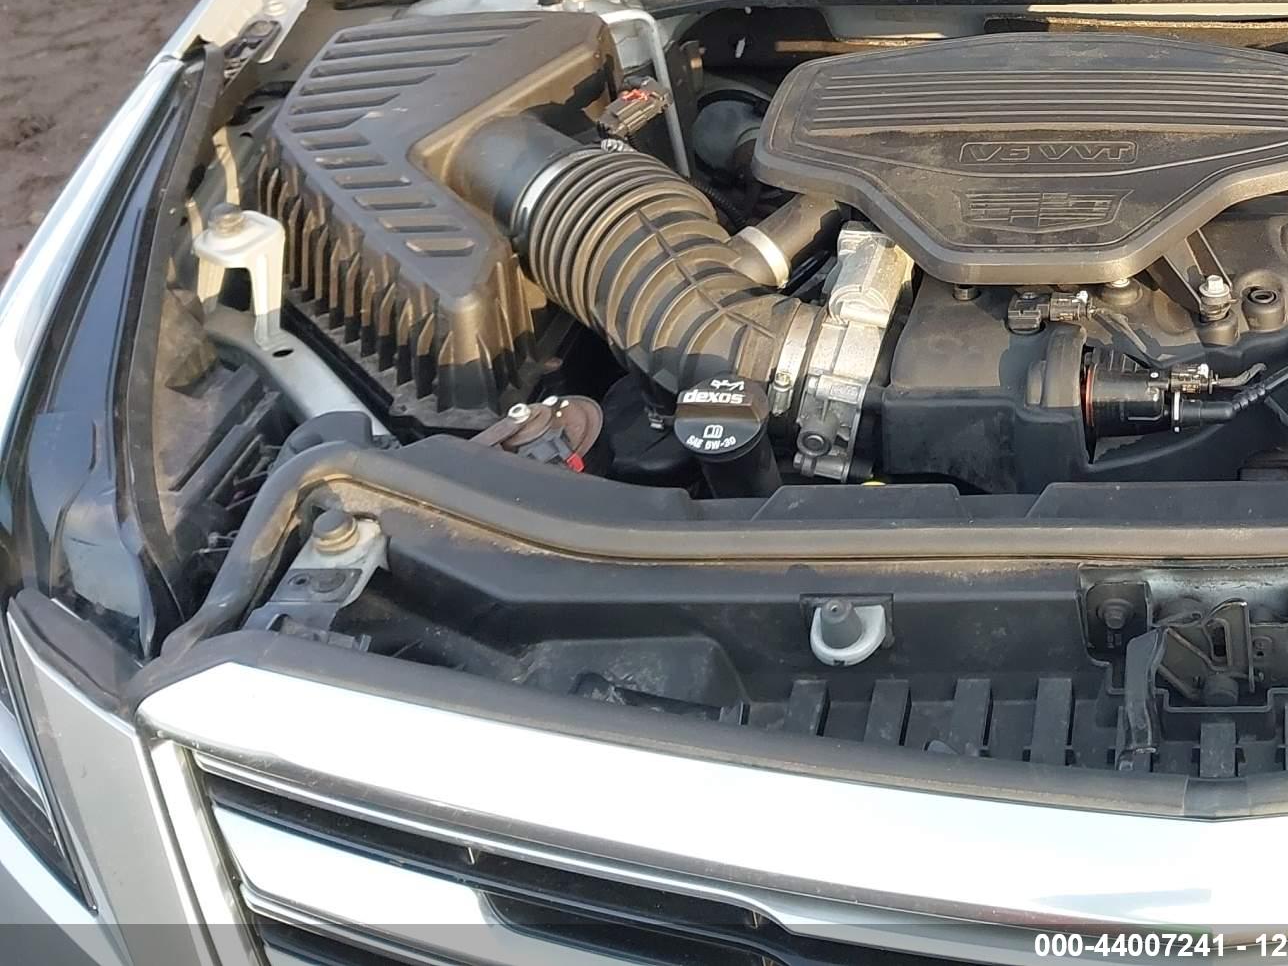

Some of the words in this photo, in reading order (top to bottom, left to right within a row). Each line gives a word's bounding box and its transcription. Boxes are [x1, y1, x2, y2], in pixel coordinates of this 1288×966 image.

[970, 144, 1031, 161] V6
[1039, 144, 1131, 161] VVT
[683, 389, 746, 404] dexos
[686, 435, 704, 449] SAE
